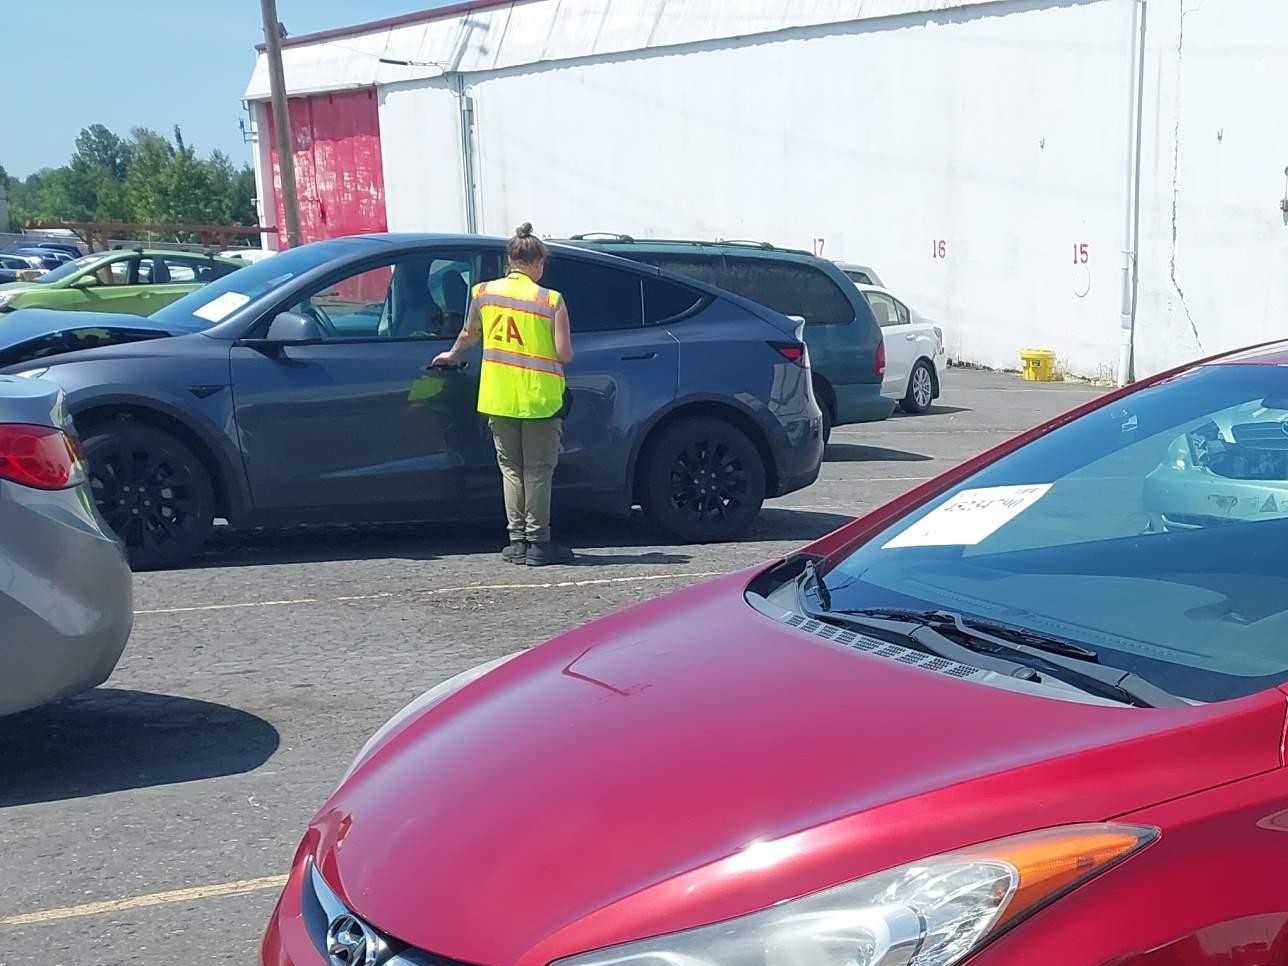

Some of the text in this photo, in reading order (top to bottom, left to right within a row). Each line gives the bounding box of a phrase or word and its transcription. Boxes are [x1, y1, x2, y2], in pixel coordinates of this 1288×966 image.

[812, 238, 825, 256] 17
[932, 239, 946, 259] 16
[1072, 243, 1089, 265] 15
